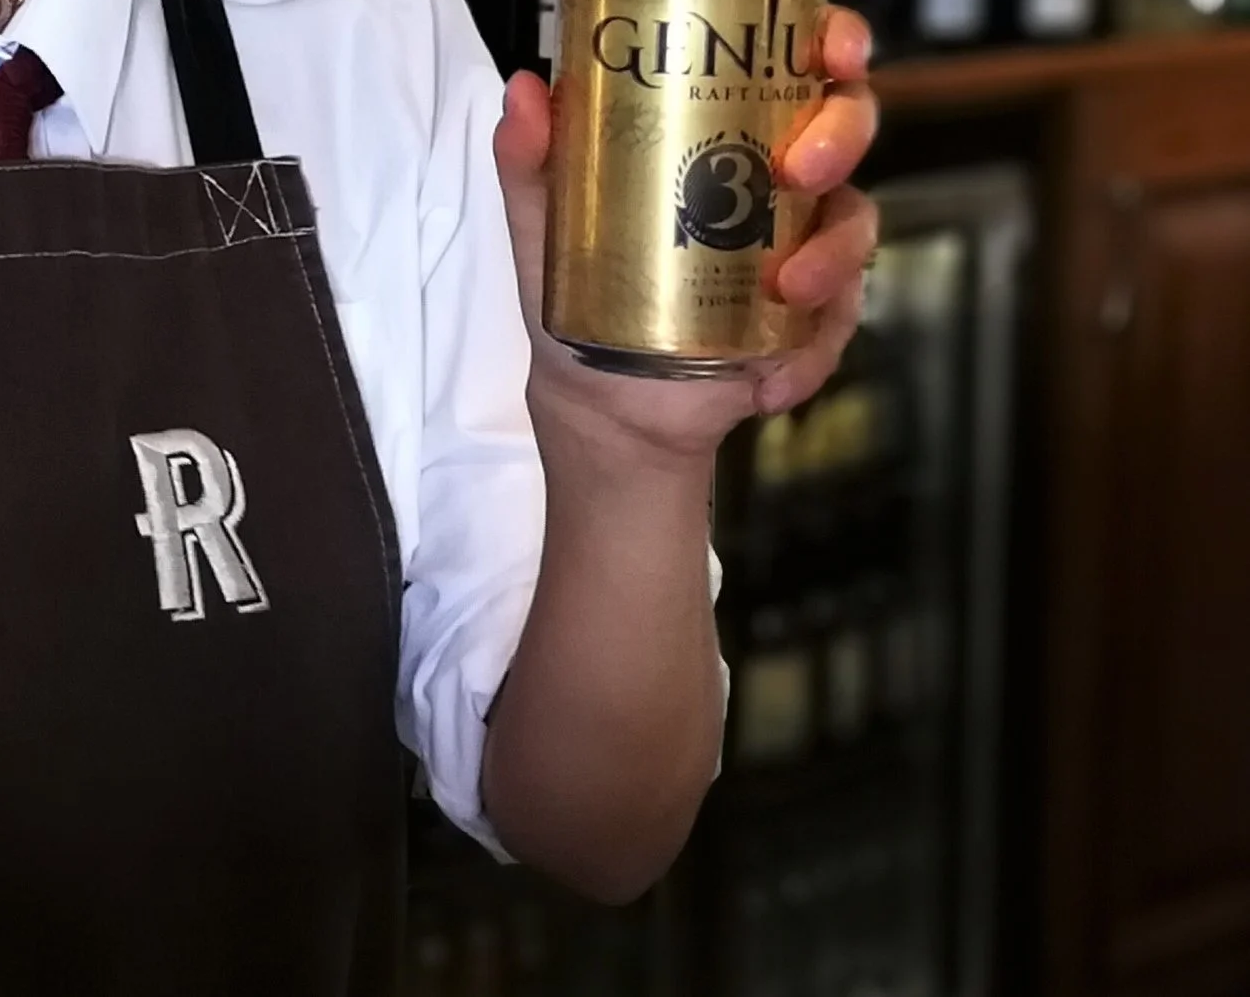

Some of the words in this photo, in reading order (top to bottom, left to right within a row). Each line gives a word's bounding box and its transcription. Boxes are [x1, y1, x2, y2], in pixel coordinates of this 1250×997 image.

[688, 85, 751, 101] RAFT
[707, 151, 754, 231] 3
[129, 427, 271, 622] R
